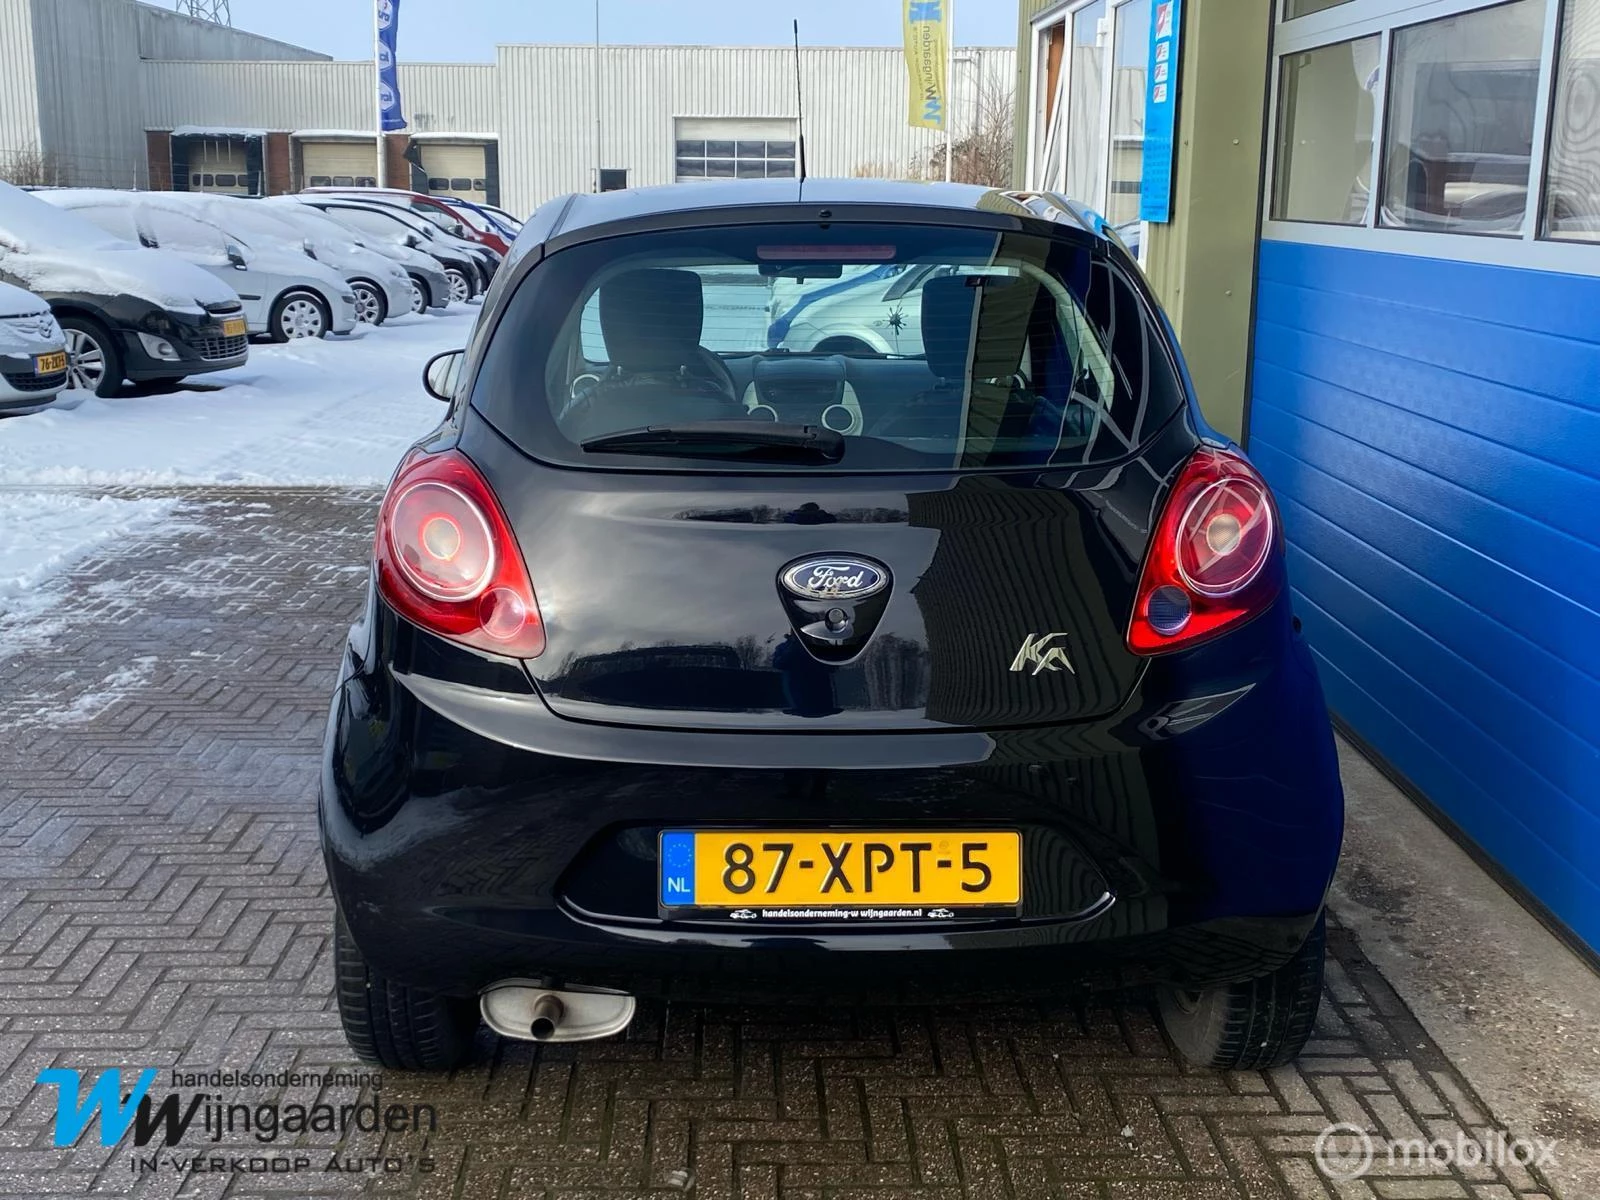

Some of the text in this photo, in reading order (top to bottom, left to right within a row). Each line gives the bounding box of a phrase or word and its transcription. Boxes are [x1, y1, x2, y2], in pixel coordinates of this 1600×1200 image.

[808, 566, 864, 589] Ford
[722, 842, 992, 894] 87-XPT-5
[667, 877, 691, 893] NL
[860, 908, 922, 919] wijngaarden.nl
